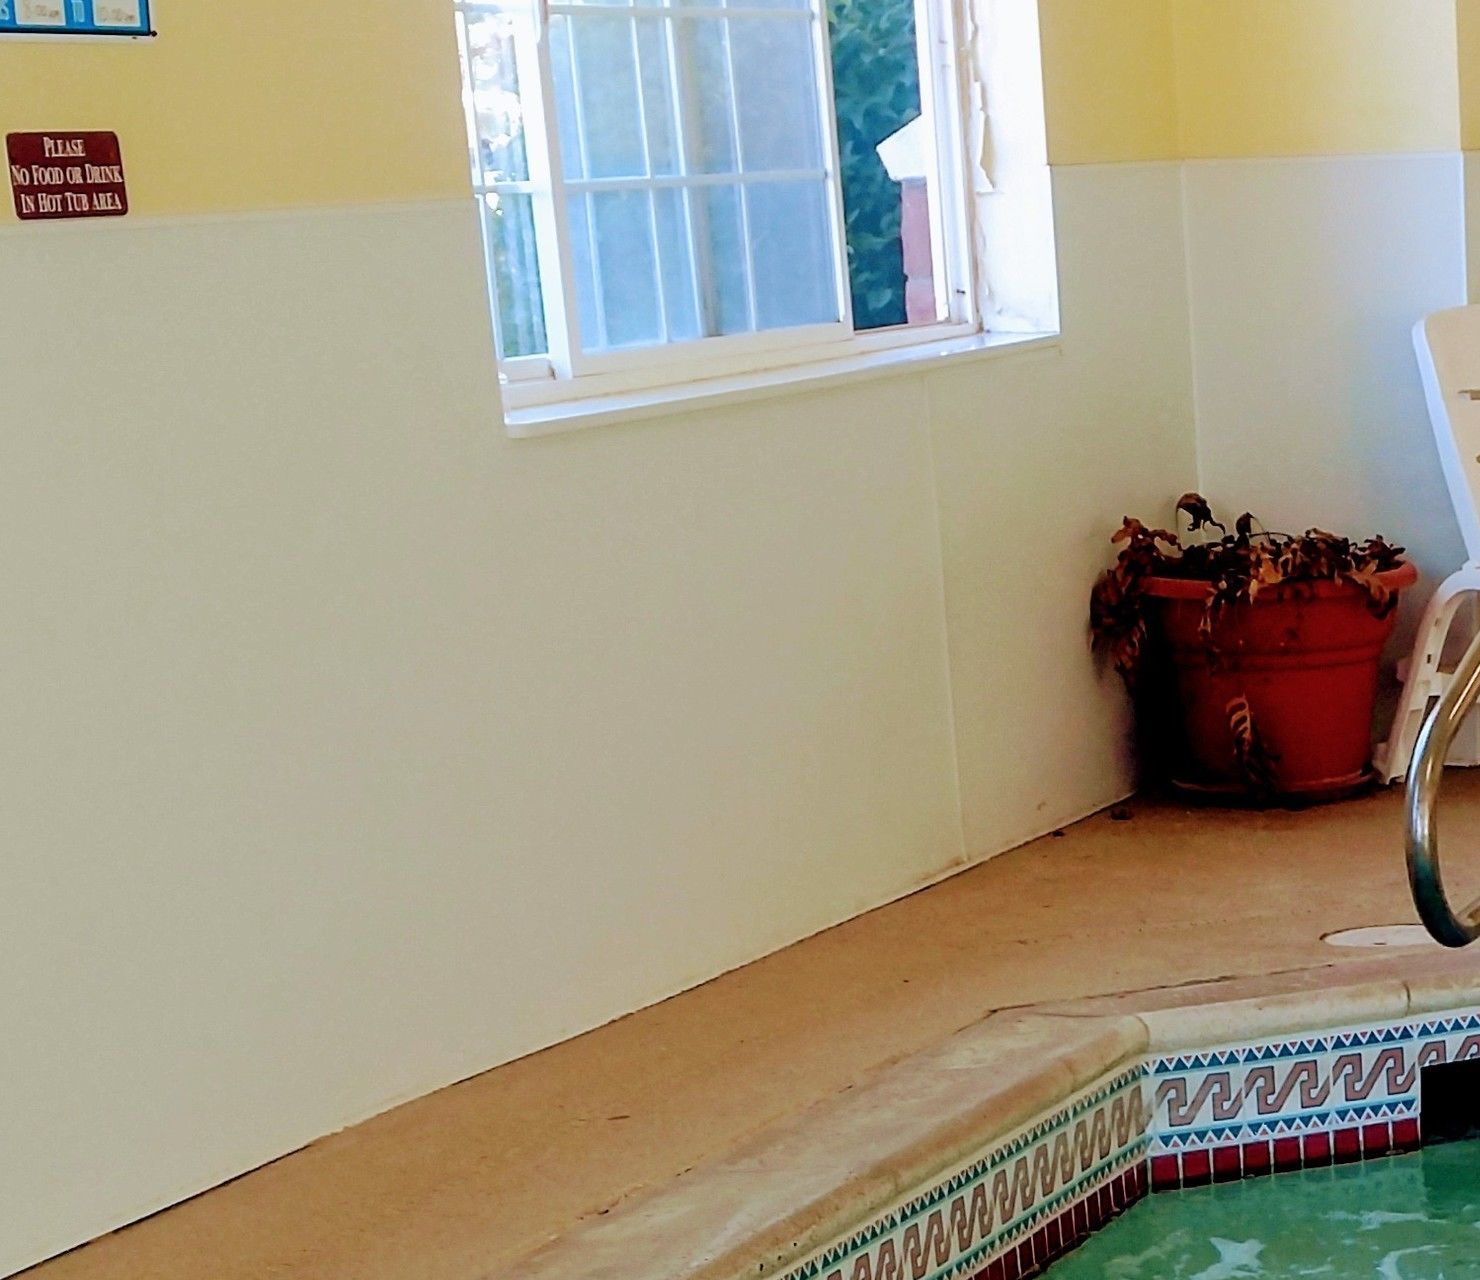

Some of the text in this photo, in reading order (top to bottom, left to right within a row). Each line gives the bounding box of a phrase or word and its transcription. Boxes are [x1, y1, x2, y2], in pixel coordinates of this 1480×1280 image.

[43, 136, 86, 157] PLEASE
[84, 163, 123, 183] DRINK
[37, 192, 62, 213] HOT
[64, 191, 89, 211] TUB
[92, 191, 122, 211] AREA
